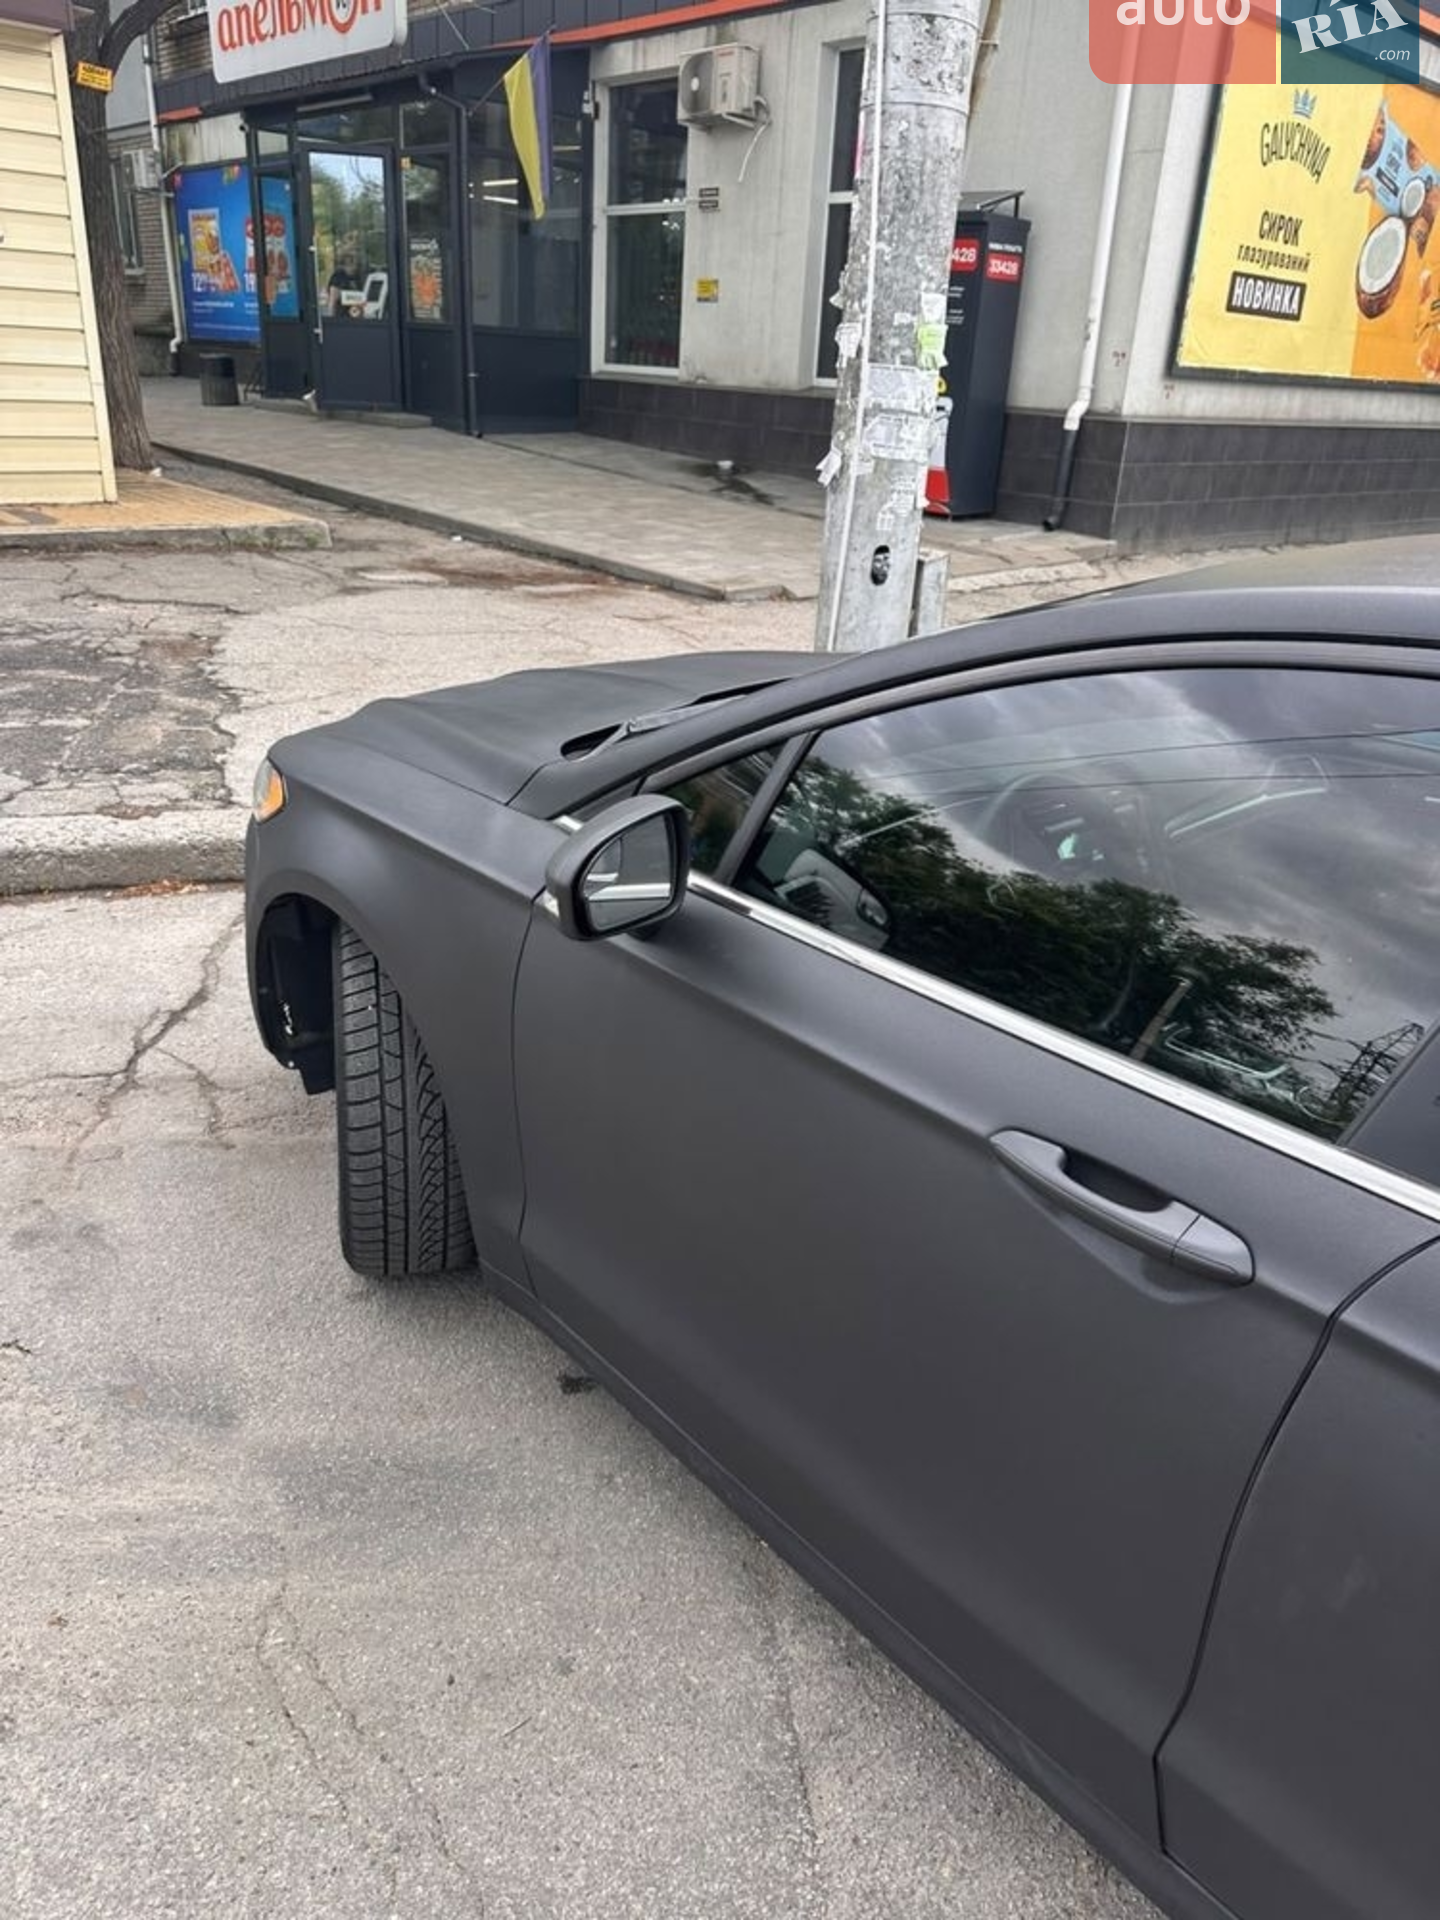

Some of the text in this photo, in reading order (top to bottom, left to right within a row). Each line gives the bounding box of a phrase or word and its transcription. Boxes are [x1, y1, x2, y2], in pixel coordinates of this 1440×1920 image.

[1260, 122, 1331, 184] GALYCHYNA
[1259, 210, 1302, 246] СИРОК
[952, 247, 977, 263] 428
[1237, 244, 1311, 272] глазурований
[1231, 275, 1300, 315] НОВИНКА
